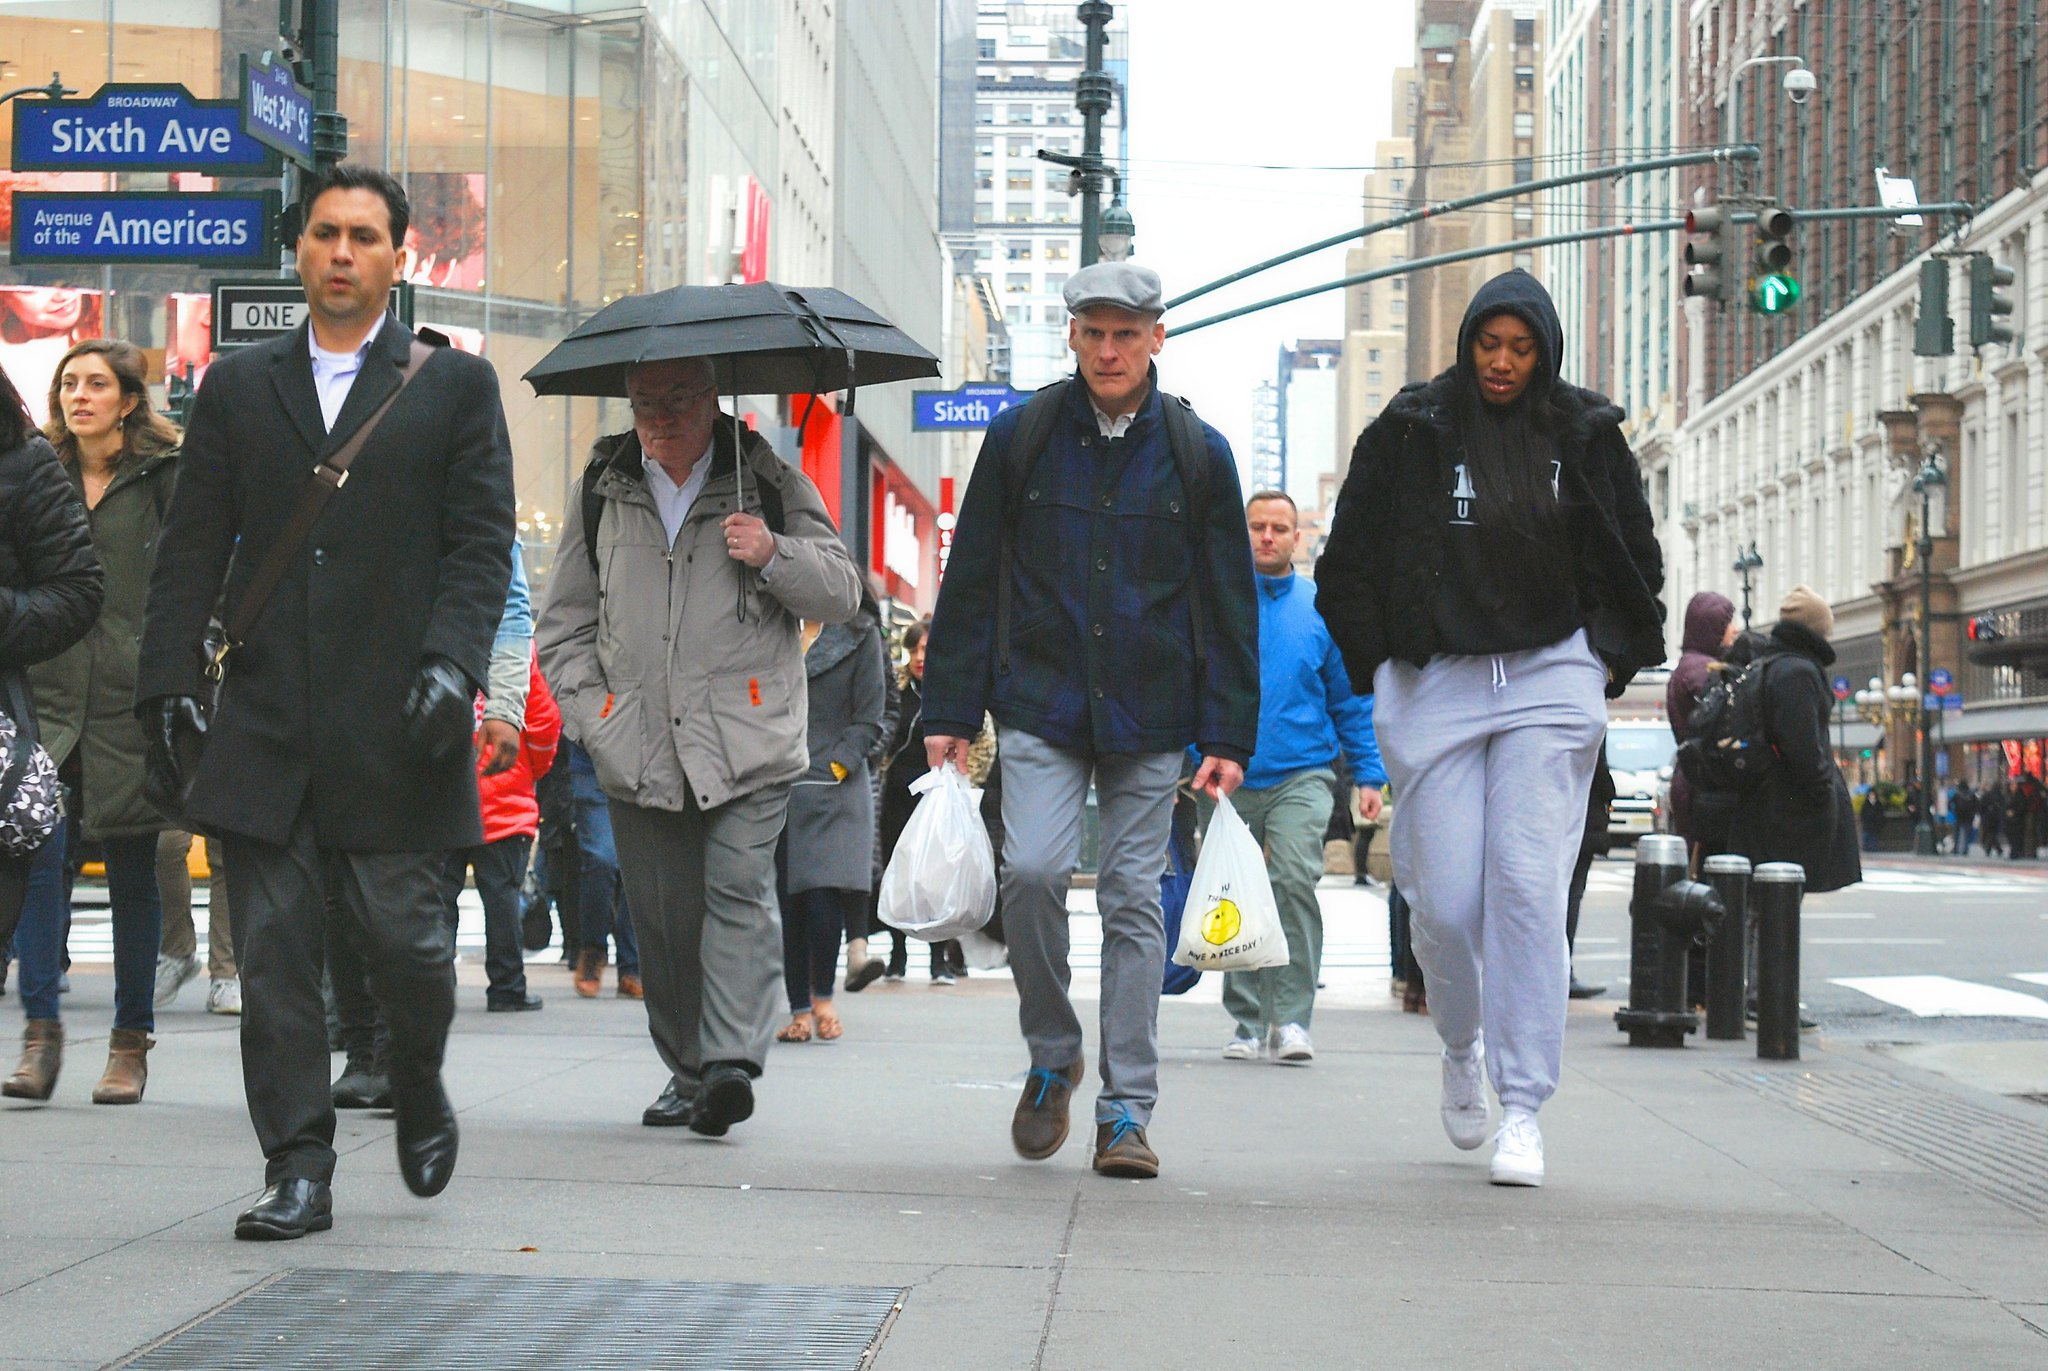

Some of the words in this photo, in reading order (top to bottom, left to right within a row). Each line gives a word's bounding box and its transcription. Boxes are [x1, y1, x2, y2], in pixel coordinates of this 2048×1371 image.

[107, 97, 179, 108] BROADWAY
[252, 80, 278, 128] West
[279, 95, 297, 134] 34th
[298, 107, 309, 144] St
[51, 117, 146, 153] Sixth
[158, 119, 232, 153] Ave
[33, 209, 93, 226] Avenue
[93, 209, 248, 246] Americas
[33, 227, 52, 245] of
[54, 228, 81, 245] the
[246, 305, 295, 327] ONE
[933, 400, 990, 422] Sixth
